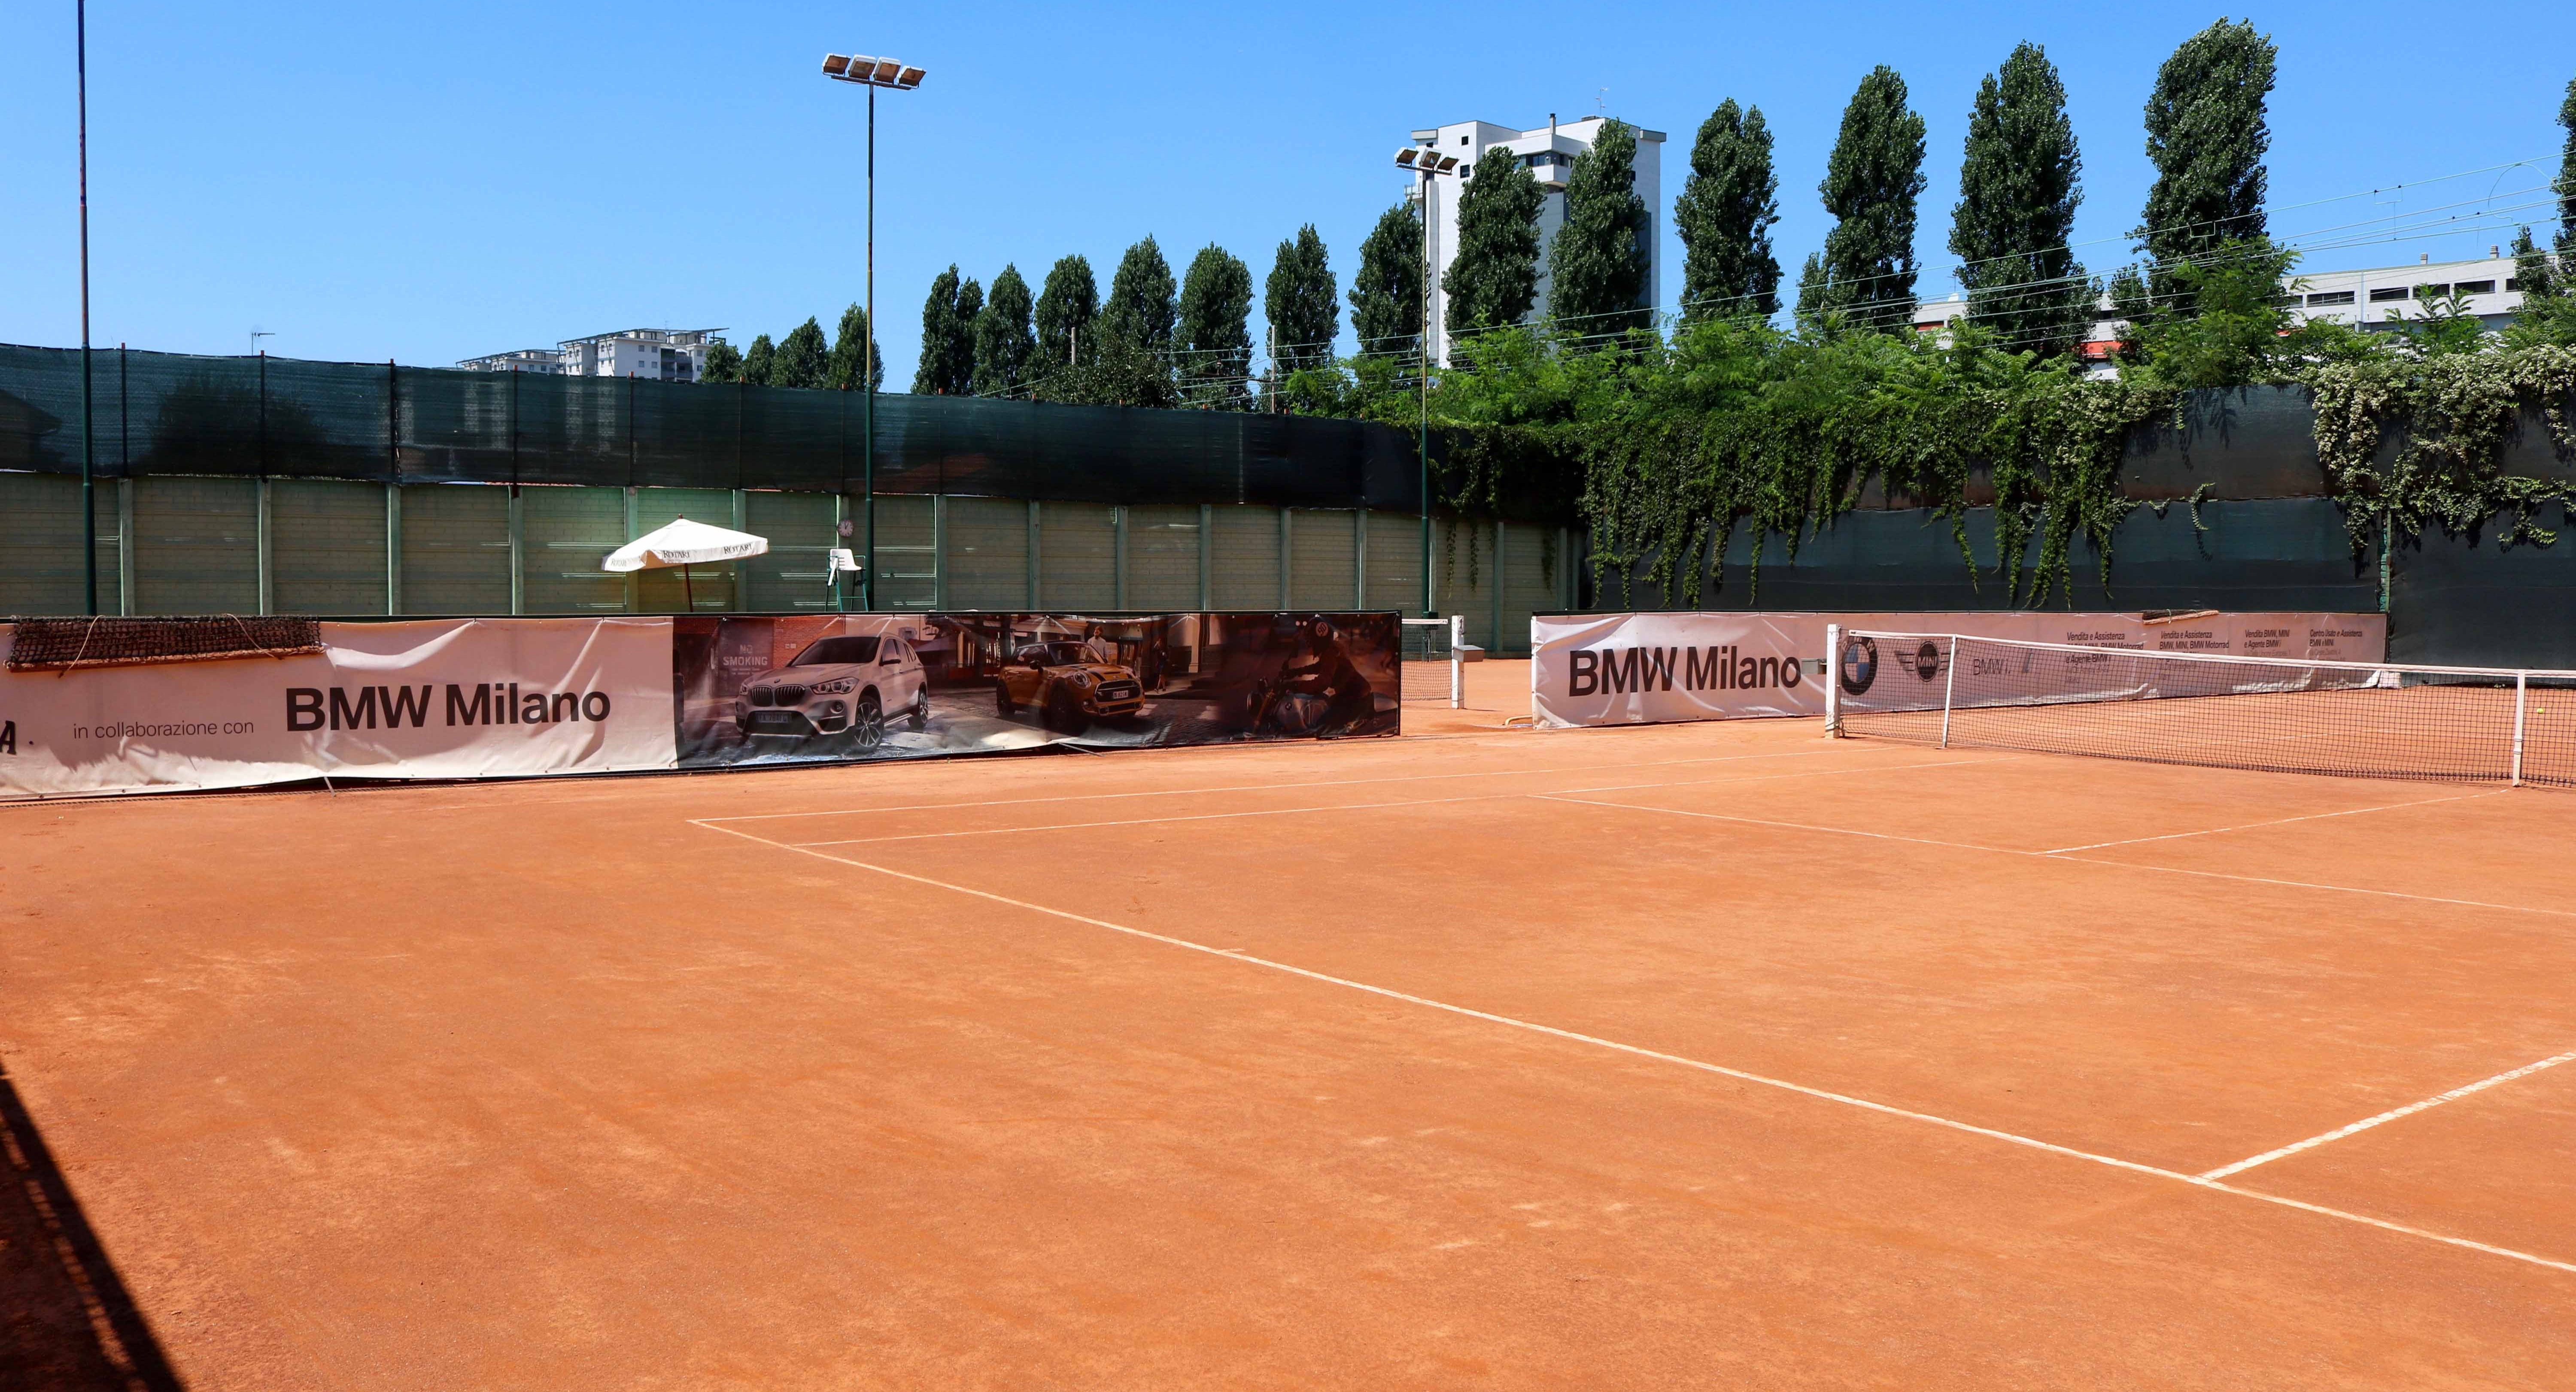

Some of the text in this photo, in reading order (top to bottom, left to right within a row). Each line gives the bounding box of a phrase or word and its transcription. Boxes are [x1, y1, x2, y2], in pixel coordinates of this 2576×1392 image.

[663, 550, 690, 558] ROTARI
[723, 543, 752, 554] ROTARI
[2067, 631, 2088, 640] Vendita
[2094, 631, 2125, 640] Assistenza
[2161, 631, 2179, 639] Vendita
[2184, 630, 2212, 639] Assistenza
[2245, 629, 2290, 639] Vendita BMW, MINI
[2175, 641, 2189, 651] MINI,
[2190, 640, 2204, 649] BMW
[2205, 640, 2230, 649] Motorrad
[2248, 640, 2265, 650] Agente
[723, 656, 768, 666] SMOKING
[1917, 656, 1937, 668] MINI
[2070, 655, 2091, 665] Agente
[2092, 654, 2108, 662] BMW
[1569, 646, 1801, 697] BMW Milano
[1973, 658, 2002, 675] BMW
[286, 682, 611, 731] BMW Milano
[73, 719, 254, 739] in collaborazione con
